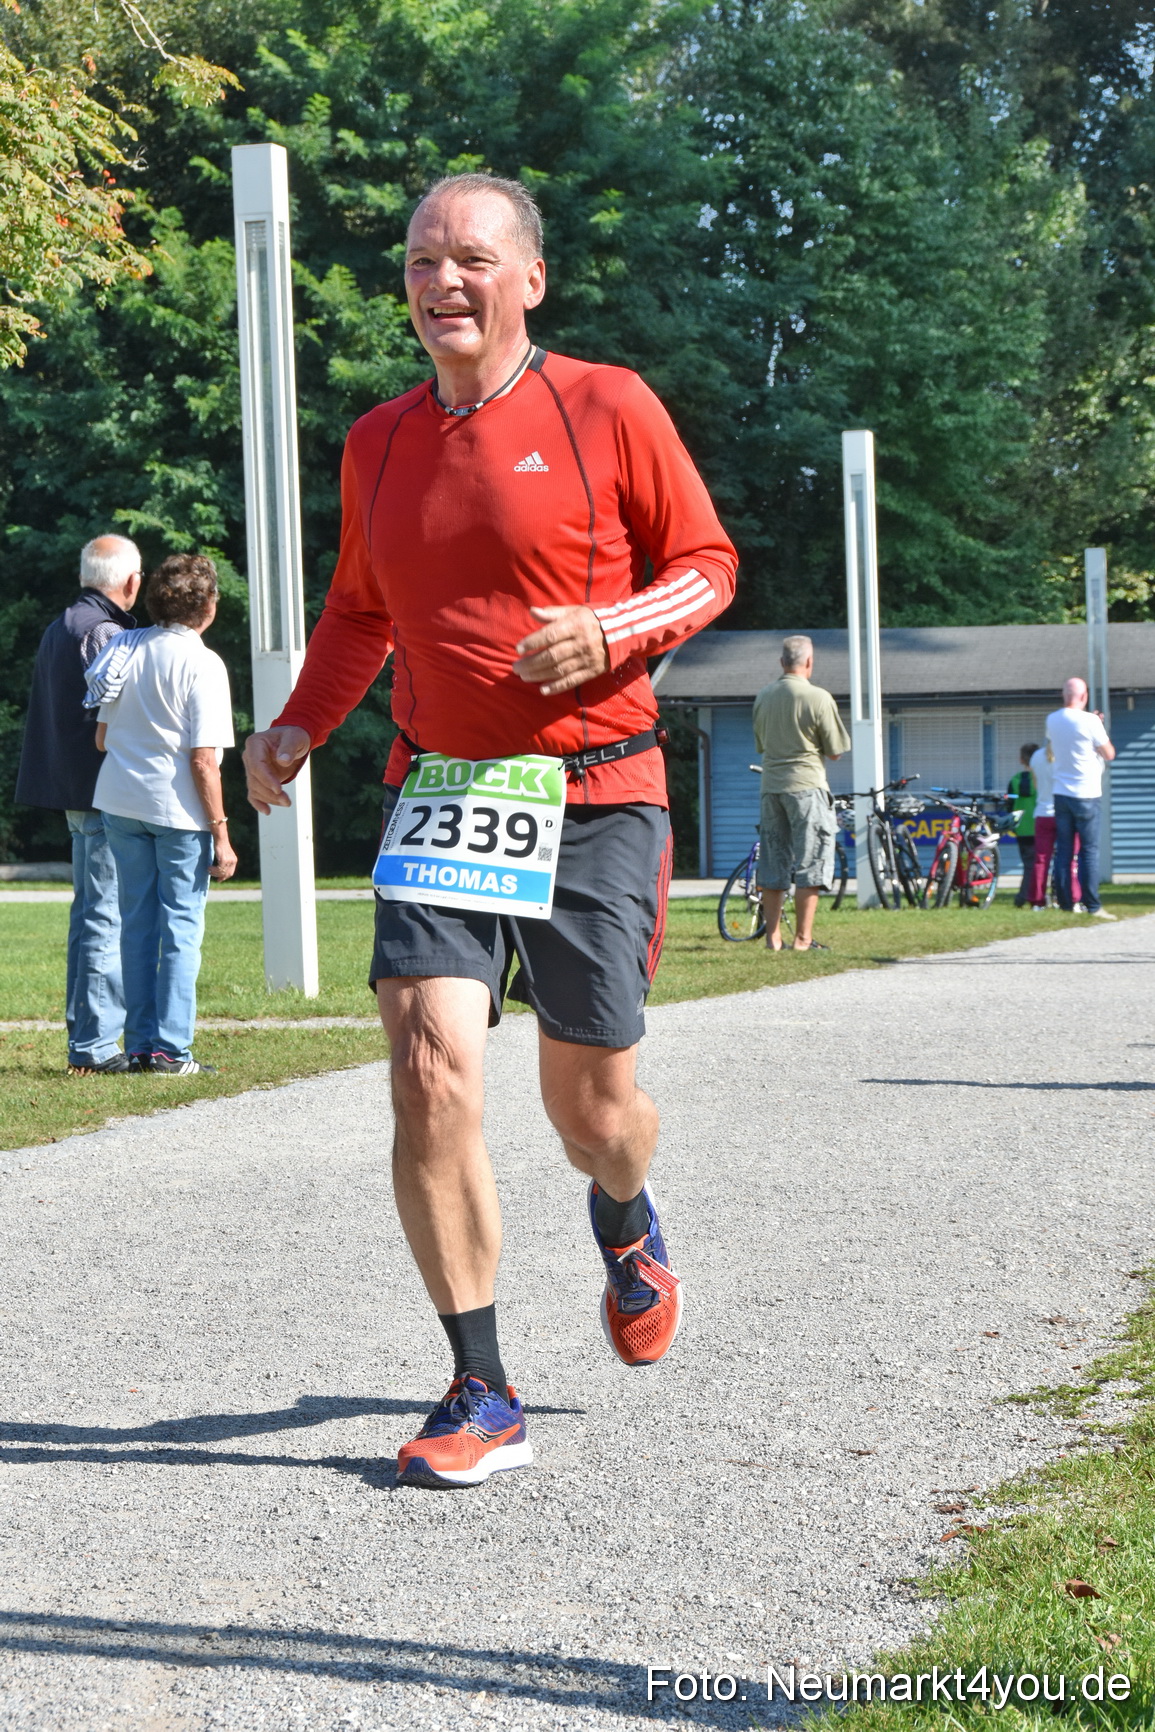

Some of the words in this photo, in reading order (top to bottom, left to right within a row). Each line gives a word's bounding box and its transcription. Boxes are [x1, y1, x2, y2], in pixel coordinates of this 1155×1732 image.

[514, 464, 549, 472] adidas
[415, 760, 548, 796] BOCK
[400, 804, 538, 858] 2339
[545, 820, 553, 828] D
[403, 862, 518, 894] THOMAS
